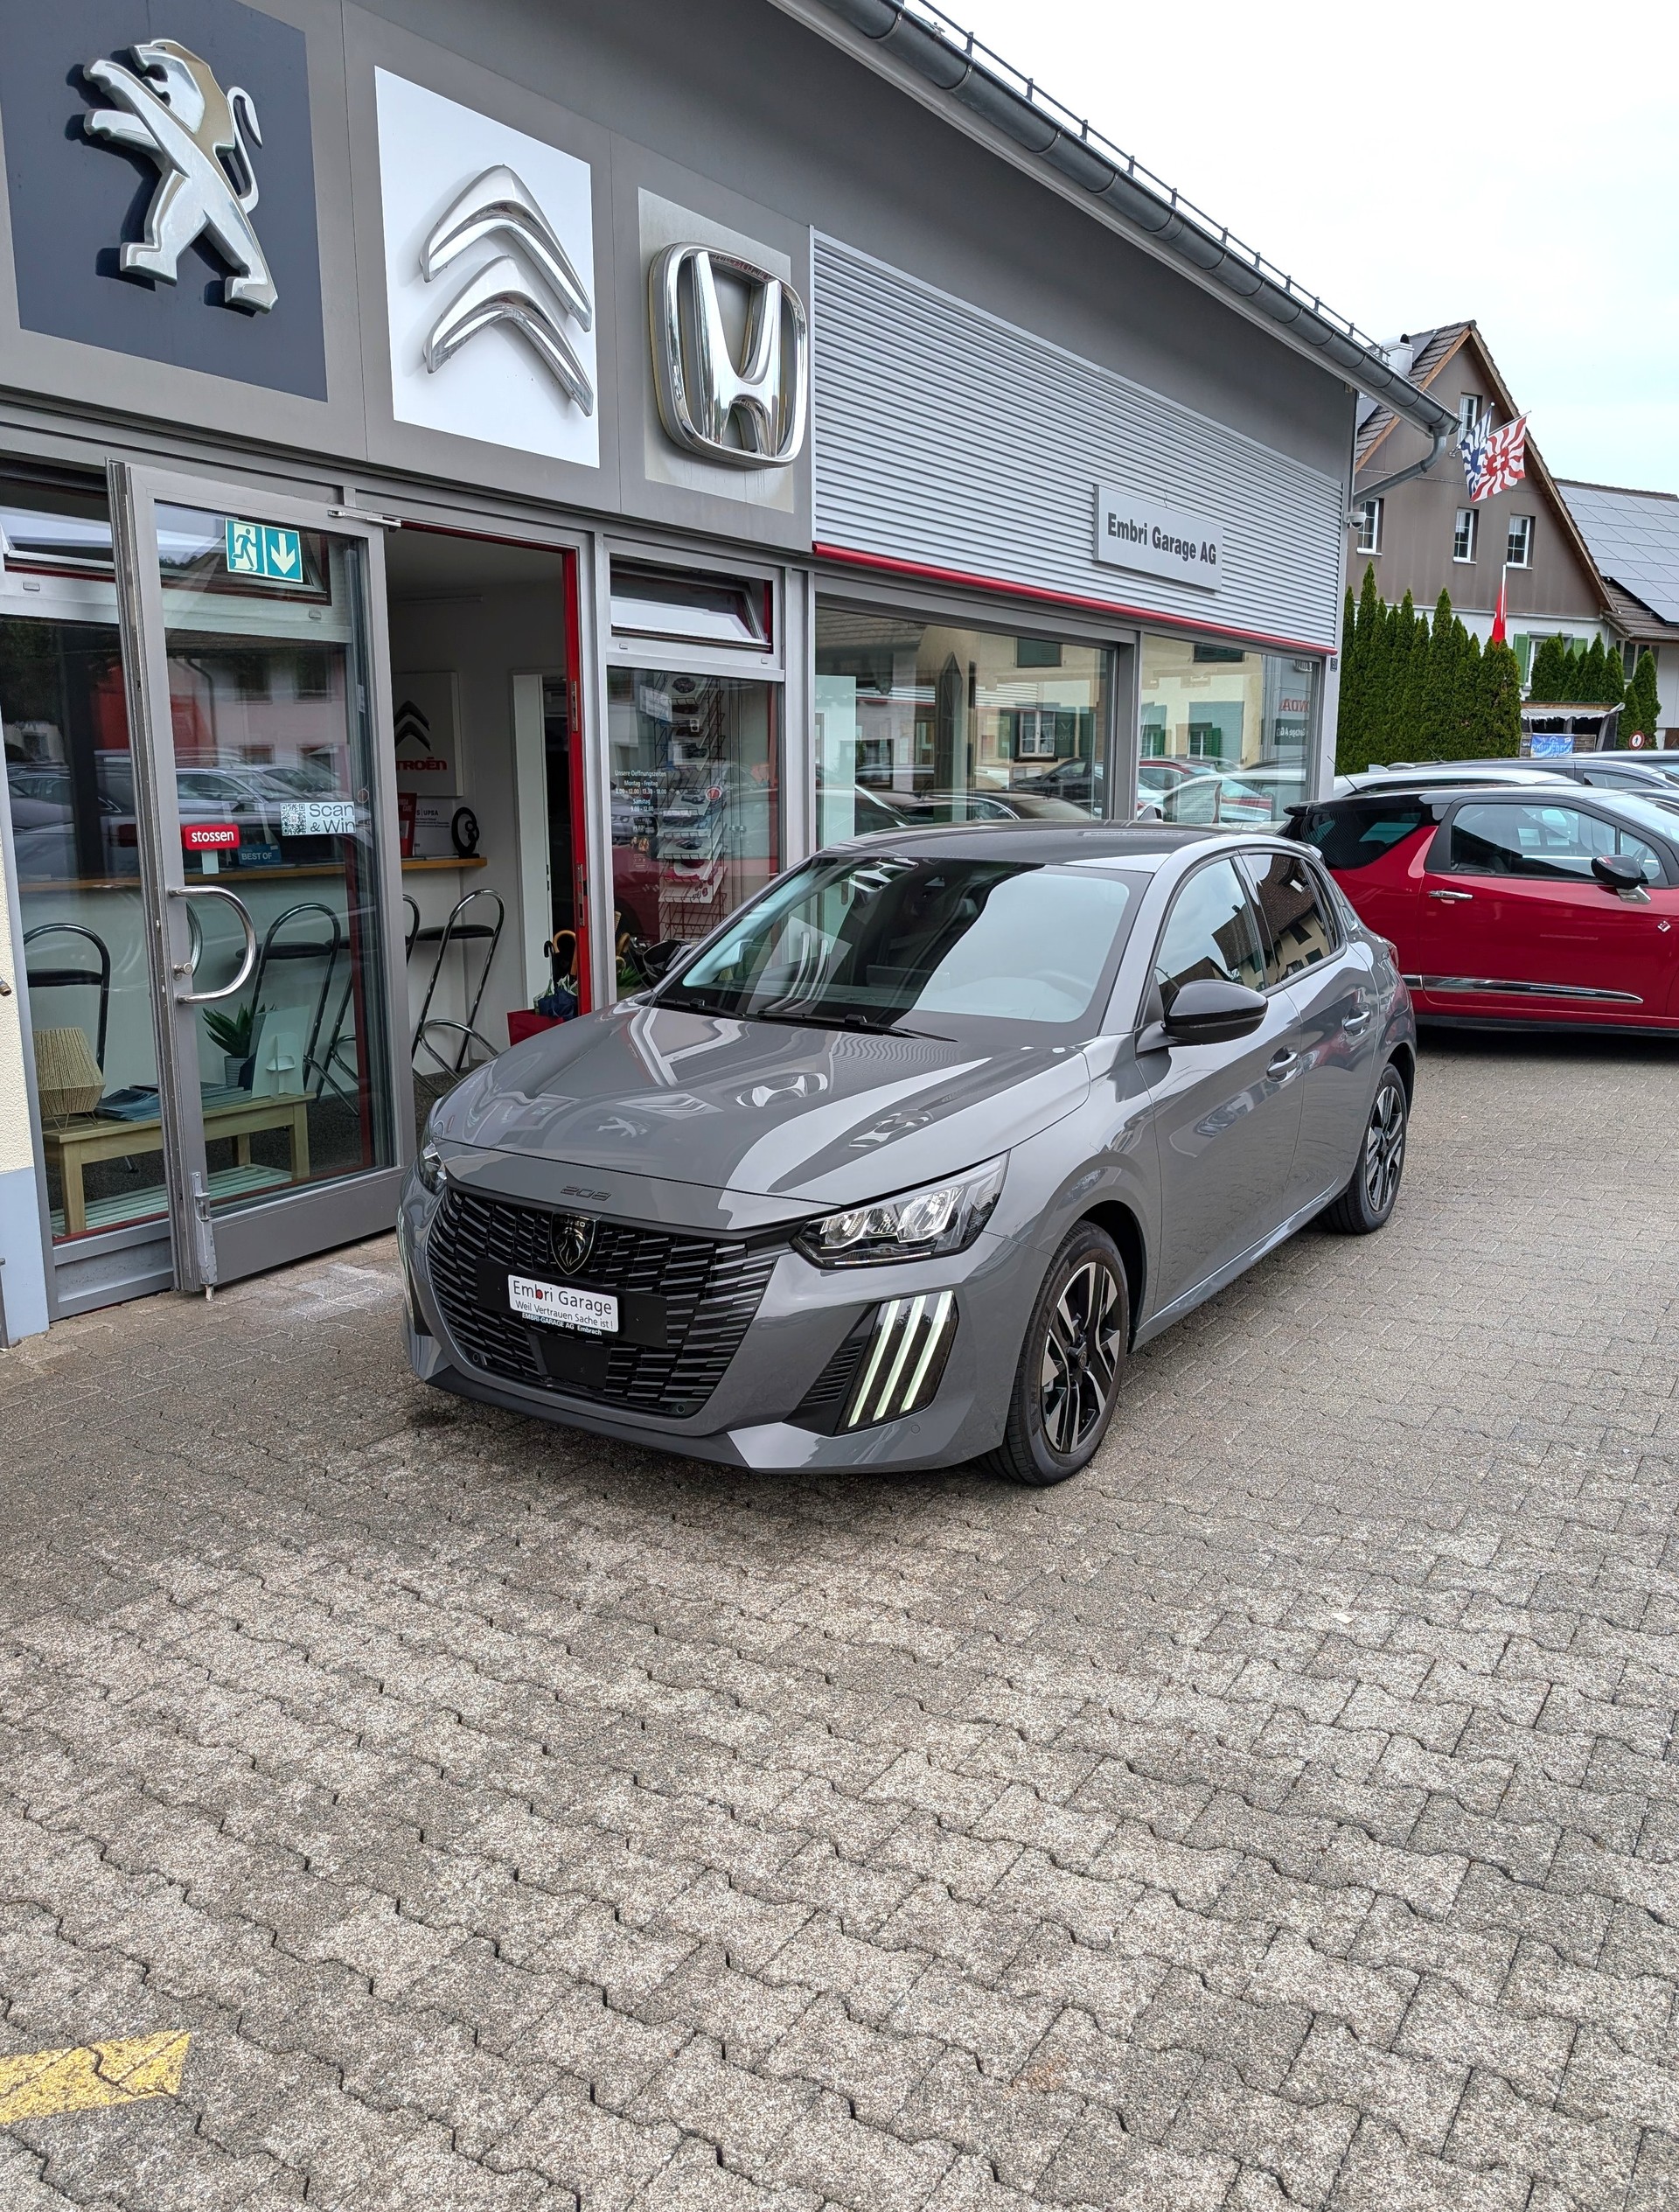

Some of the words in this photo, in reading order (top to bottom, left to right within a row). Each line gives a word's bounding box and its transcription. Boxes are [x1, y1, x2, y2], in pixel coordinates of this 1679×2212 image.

[1107, 512, 1147, 546] Embri
[1152, 526, 1197, 562] Garage
[1199, 541, 1216, 566] AG
[396, 757, 448, 771] TROËN
[624, 779, 641, 788] Montag
[309, 803, 355, 818] Scan
[310, 821, 321, 832] &
[323, 818, 355, 834] Win
[191, 830, 234, 843] stossen
[241, 852, 262, 861] BEST
[561, 1185, 612, 1202] 208
[512, 1280, 554, 1302] Embri
[558, 1290, 612, 1316] Garage
[515, 1299, 533, 1312] Weil
[533, 1303, 573, 1321] Vertrauen
[575, 1313, 598, 1326] Sache
[600, 1318, 610, 1329] ist
[521, 1312, 565, 1329] EMBRI-GARAGE
[576, 1324, 603, 1336] Embrach
